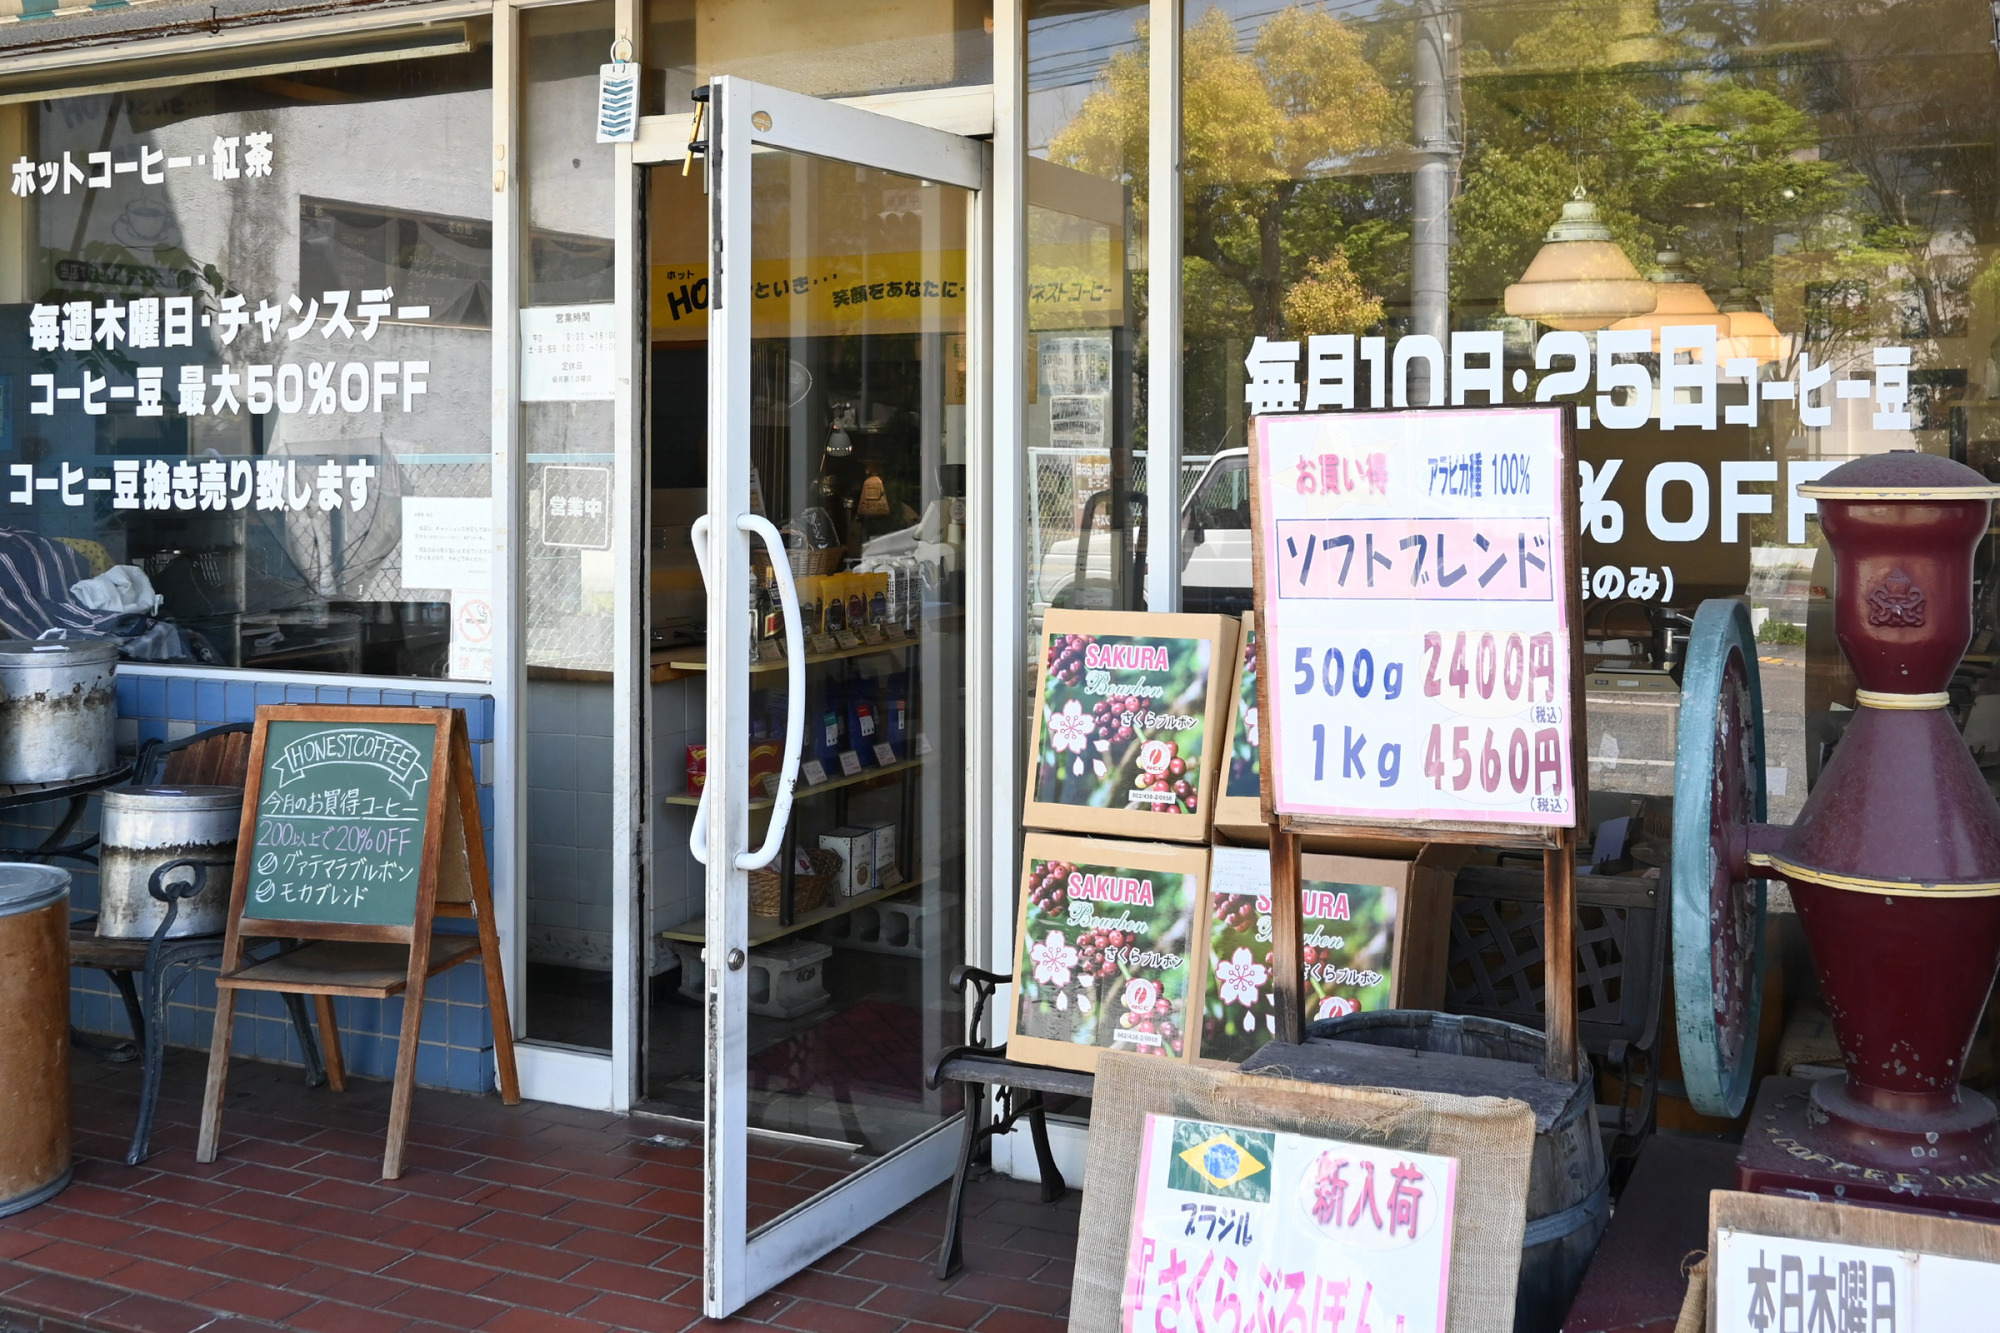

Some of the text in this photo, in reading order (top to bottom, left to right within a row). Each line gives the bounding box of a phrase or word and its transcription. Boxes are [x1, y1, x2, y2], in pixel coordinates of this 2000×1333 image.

[666, 269, 695, 280] ホット
[1028, 281, 1112, 304] ネストコーヒー
[30, 286, 431, 351] 毎週木曜日・チャンスデー
[555, 311, 591, 323] 営業時間
[561, 362, 583, 371] 定休日
[31, 367, 164, 417] コーヒー豆
[10, 458, 375, 511] コーヒー豆挽き売り致します
[1295, 452, 1531, 499] お買い得 アラビカ種 100%
[549, 496, 602, 518] 営業中
[1287, 532, 1547, 589] ソフトブレンド
[1581, 563, 1674, 602] のみ)
[1085, 643, 1169, 671] SAKURA
[1294, 631, 1555, 704] 500g 2400円
[1084, 669, 1164, 698] Bourbon
[1120, 710, 1198, 731] さくらブルボン
[1424, 723, 1562, 798] 4560円
[262, 788, 419, 818] 今月のお買得コーヒー
[280, 882, 369, 908] モカブレンド
[1067, 872, 1154, 906] SAKURA
[1256, 889, 1350, 920] SURA
[1066, 900, 1148, 935] Bourbon
[1104, 945, 1185, 970] さくらブルボン
[1311, 1149, 1425, 1240] 新入荷
[1180, 1202, 1253, 1247] ブラジル
[1747, 1249, 1896, 1333] 本日木曜日
